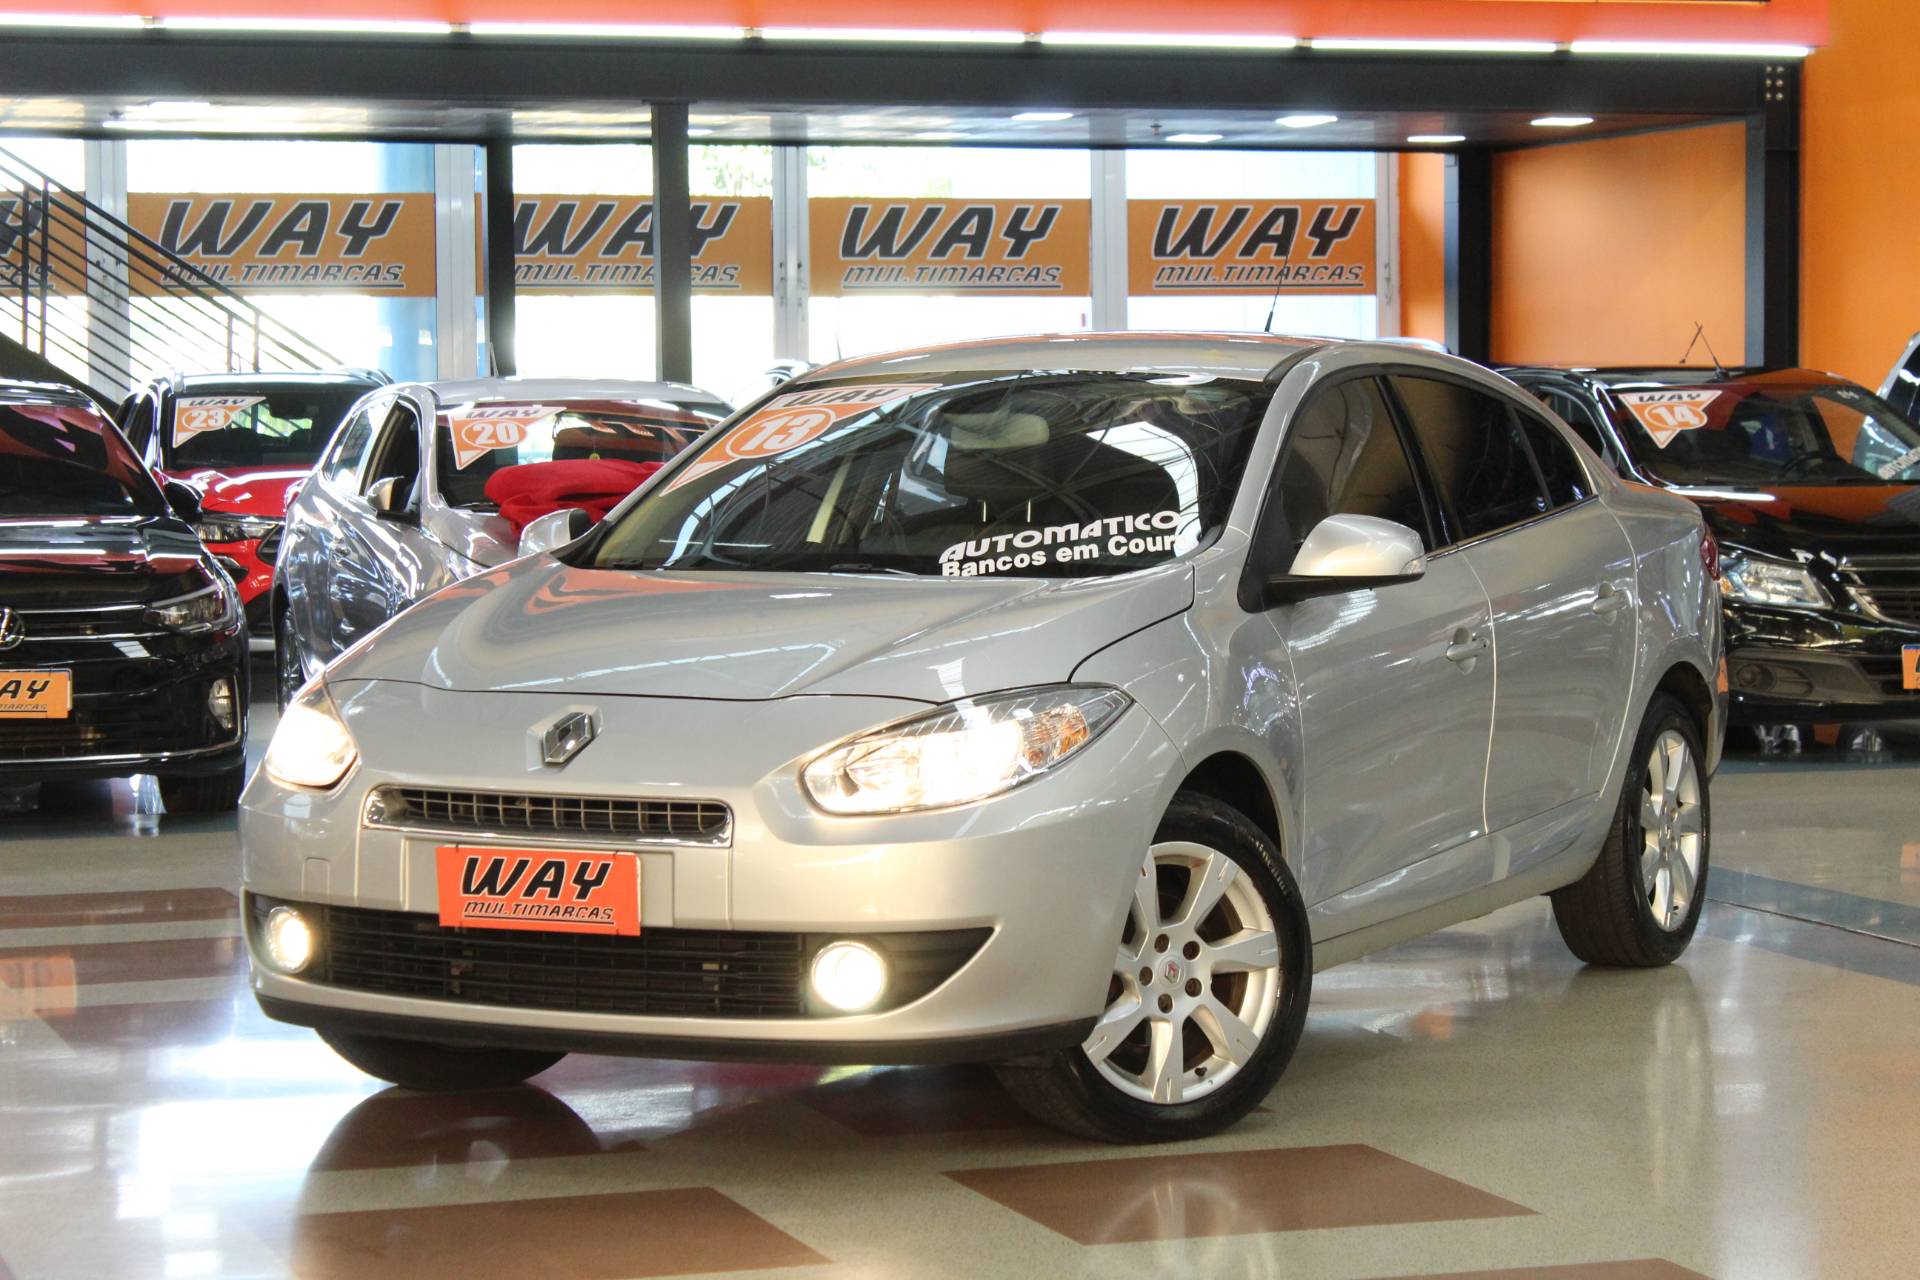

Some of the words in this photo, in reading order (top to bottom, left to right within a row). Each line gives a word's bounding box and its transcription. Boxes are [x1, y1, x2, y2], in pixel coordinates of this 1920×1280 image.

[159, 201, 403, 257] WAY
[840, 206, 1060, 259] WAY
[1153, 207, 1363, 258] WAY
[843, 266, 1062, 282] MULTIMARCAS
[1155, 265, 1364, 281] MULTIMARCAS
[784, 388, 899, 408] WAY
[1638, 393, 1701, 403] WAY
[190, 409, 224, 428] 23
[473, 423, 519, 444] 20
[741, 413, 825, 450] 13
[938, 510, 1180, 563] AUTOMATICO
[942, 552, 1047, 576] Bancos
[1056, 544, 1099, 563] em
[1108, 534, 1177, 556] Cour
[0, 679, 51, 699] AY
[461, 856, 613, 901] WAY
[464, 901, 614, 920] MULTIMARCAS
